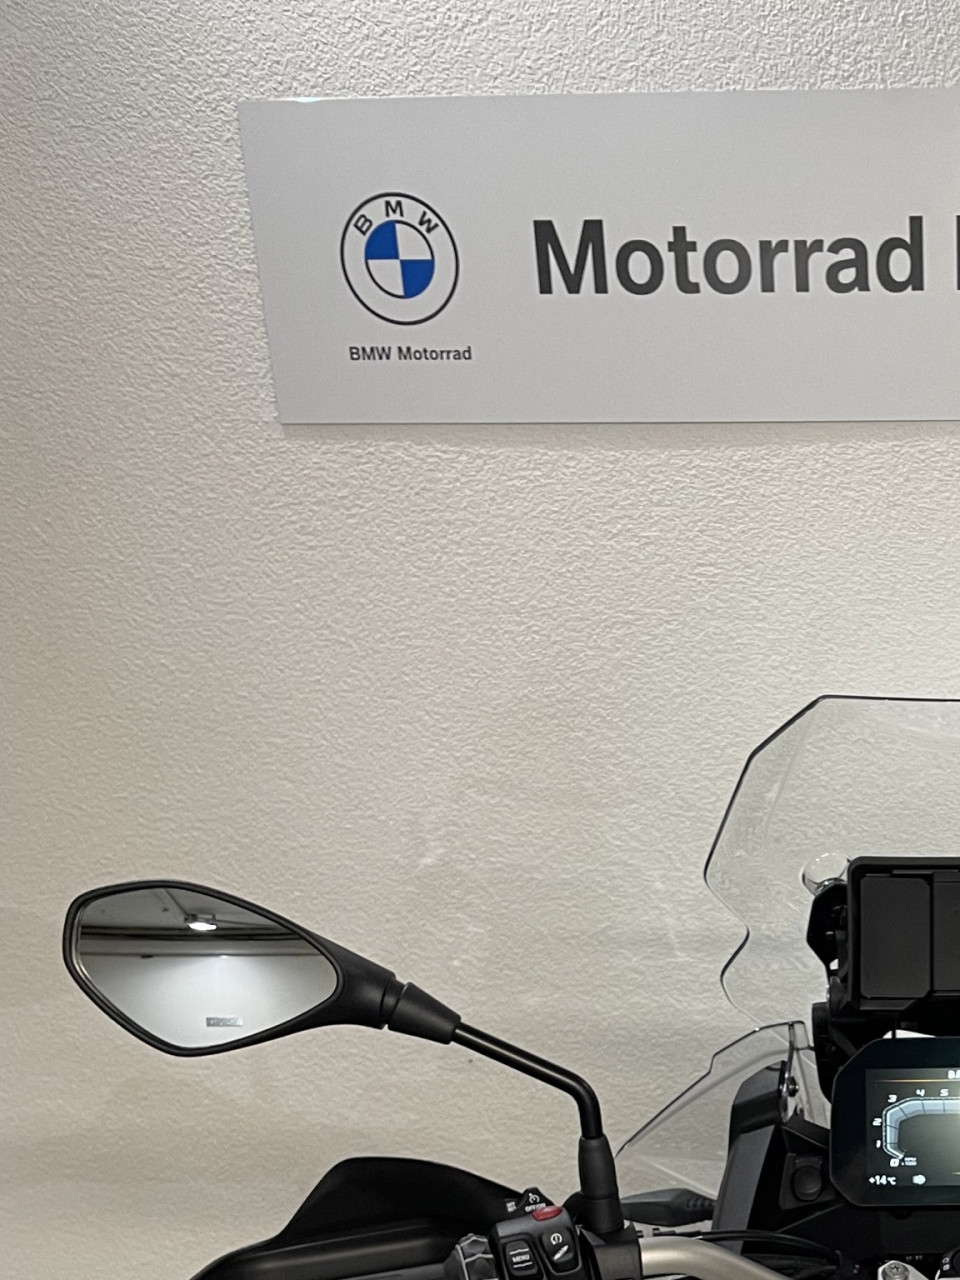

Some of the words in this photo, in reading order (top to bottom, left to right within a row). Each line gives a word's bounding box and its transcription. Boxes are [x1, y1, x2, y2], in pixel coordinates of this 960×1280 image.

[353, 200, 439, 236] BMW
[535, 217, 923, 294] Motorrad
[349, 346, 391, 361] BMW
[398, 346, 472, 361] Motorrad
[940, 1088, 949, 1096] 5
[888, 1095, 897, 1103] 3
[872, 1118, 882, 1126] 2
[876, 1140, 881, 1148] 1
[512, 1254, 530, 1263] MENU
